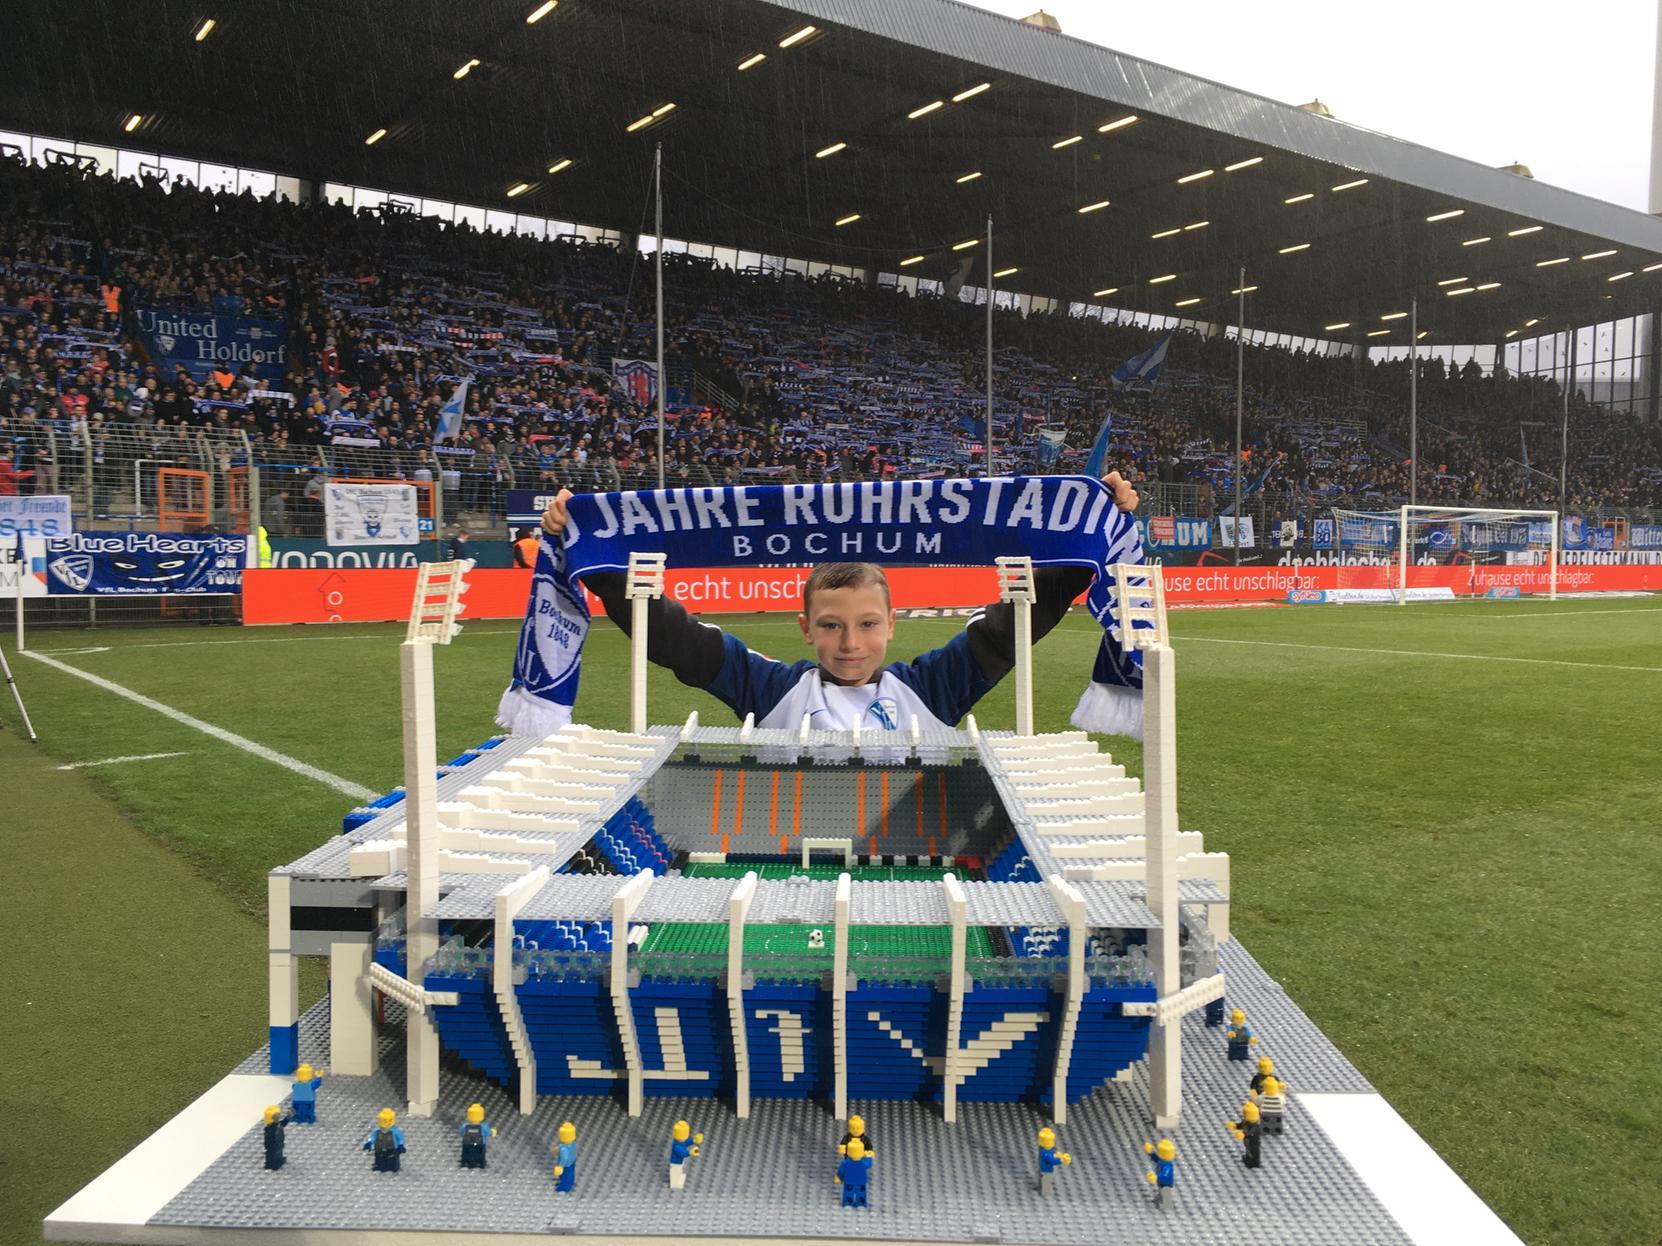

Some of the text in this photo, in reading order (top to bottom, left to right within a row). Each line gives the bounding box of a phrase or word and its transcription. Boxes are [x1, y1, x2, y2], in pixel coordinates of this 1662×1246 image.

[135, 309, 218, 338] United
[196, 340, 287, 363] Holdorf
[593, 484, 766, 539] JAHRE
[419, 520, 433, 531] 21
[49, 533, 246, 553] Blue Hearts
[733, 532, 942, 557] BOCHUM
[673, 575, 731, 600] echt
[1196, 572, 1229, 591] echt
[1513, 567, 1536, 586] echt
